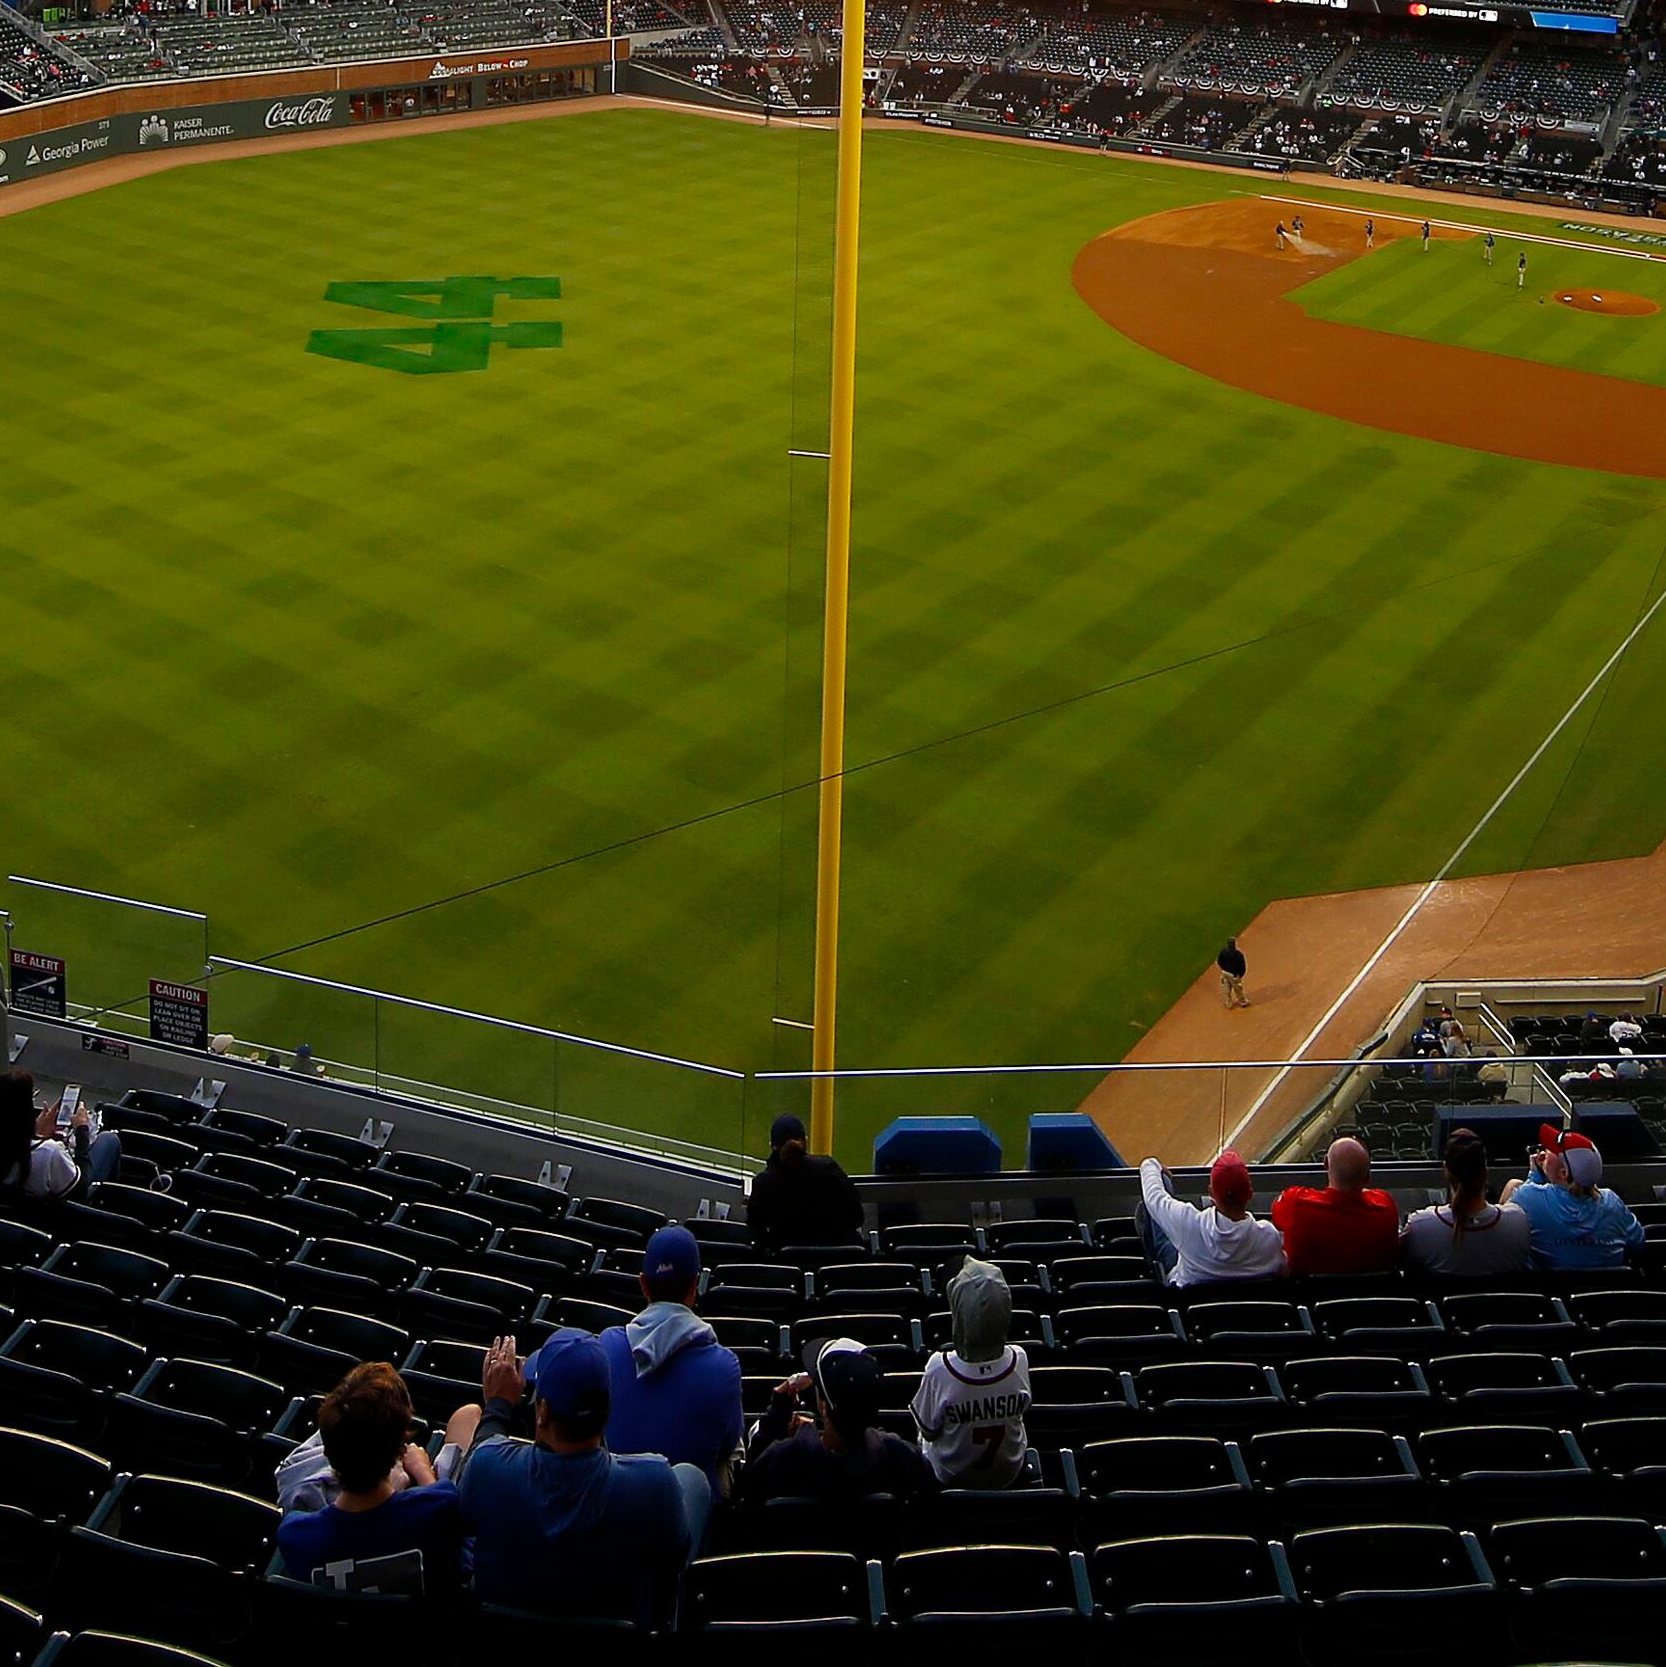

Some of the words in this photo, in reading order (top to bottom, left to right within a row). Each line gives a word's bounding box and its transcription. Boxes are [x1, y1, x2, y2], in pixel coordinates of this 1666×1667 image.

[174, 117, 203, 130] KAISER
[264, 97, 335, 129] Coca-Cola
[174, 125, 232, 141] PERMANENTE
[43, 142, 79, 161] Georgia
[81, 135, 110, 151] Power
[13, 953, 27, 965] BE
[29, 957, 59, 972] ALERT
[155, 983, 200, 1002] CAUTION
[945, 1393, 1029, 1424] SWANSON
[972, 1424, 1006, 1470] 7
